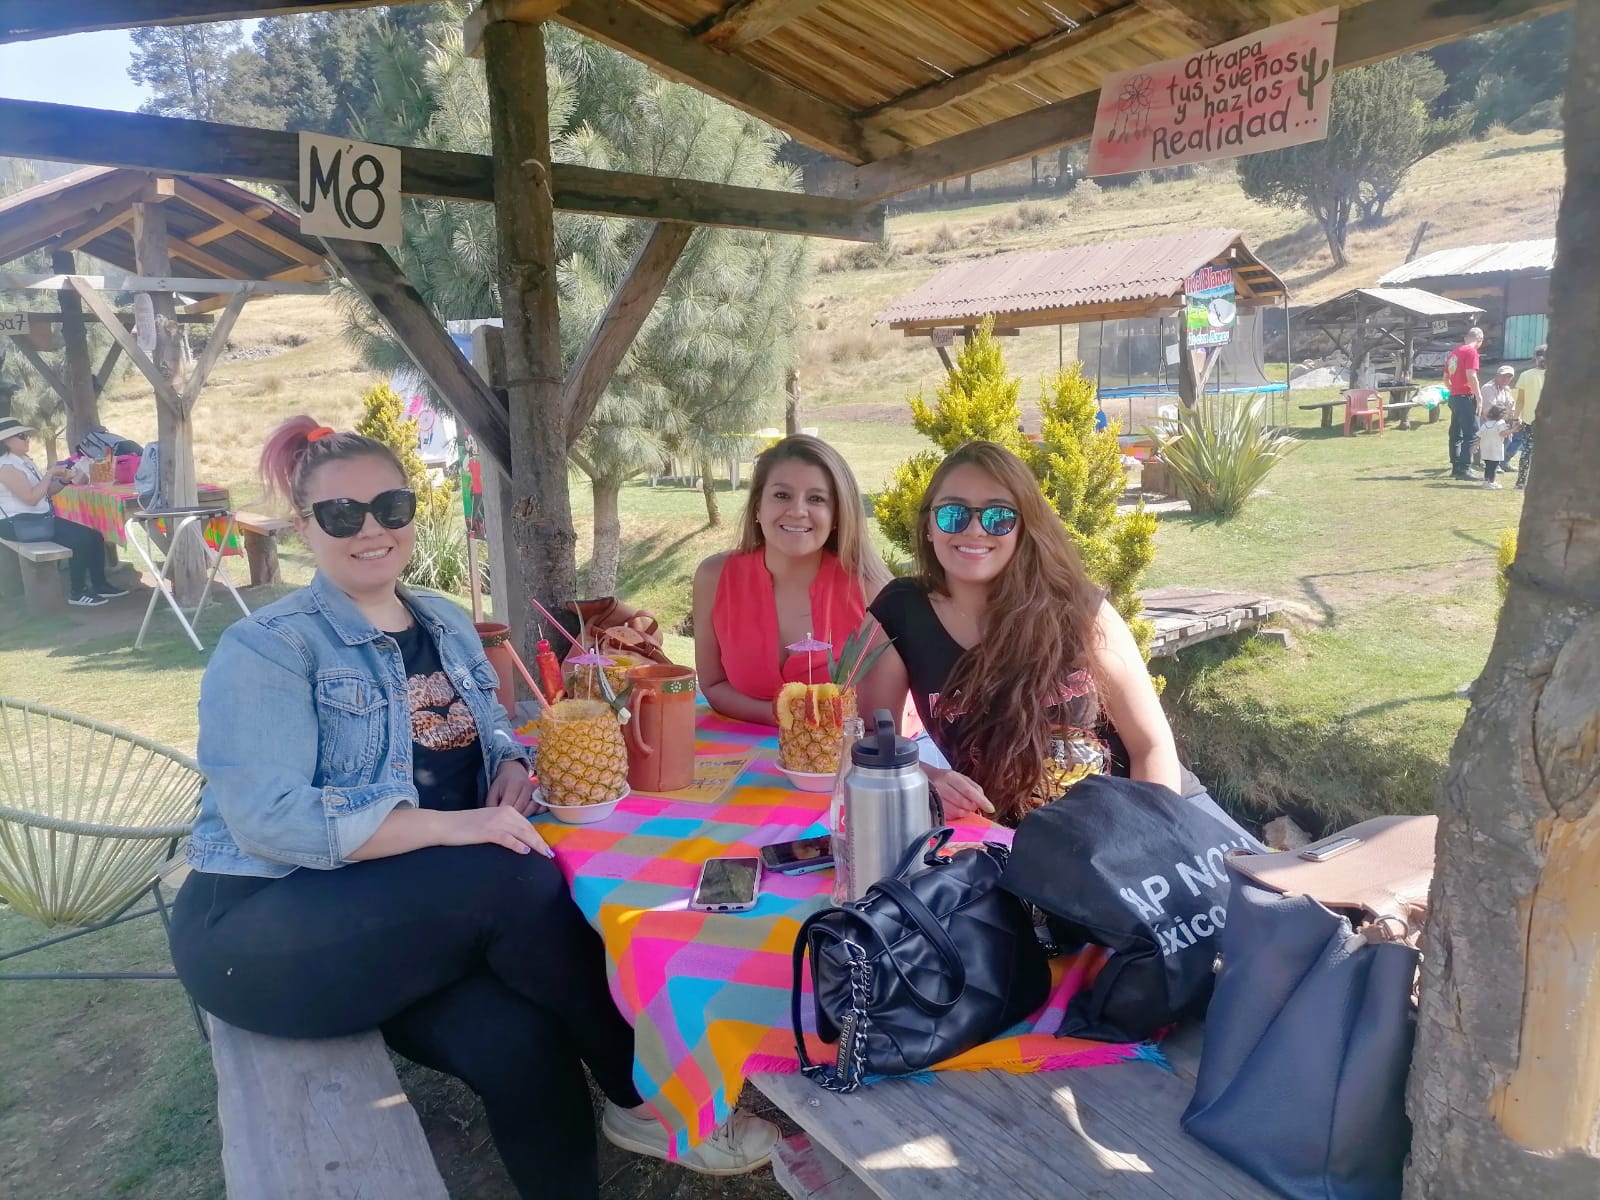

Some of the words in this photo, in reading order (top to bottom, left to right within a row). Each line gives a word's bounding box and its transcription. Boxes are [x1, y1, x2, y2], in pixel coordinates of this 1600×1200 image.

[1167, 75, 1204, 105] tus
[1212, 51, 1298, 94] sueños
[1174, 103, 1187, 125] y
[1203, 79, 1284, 119] hazlos
[840, 1023, 851, 1047] STEVE
